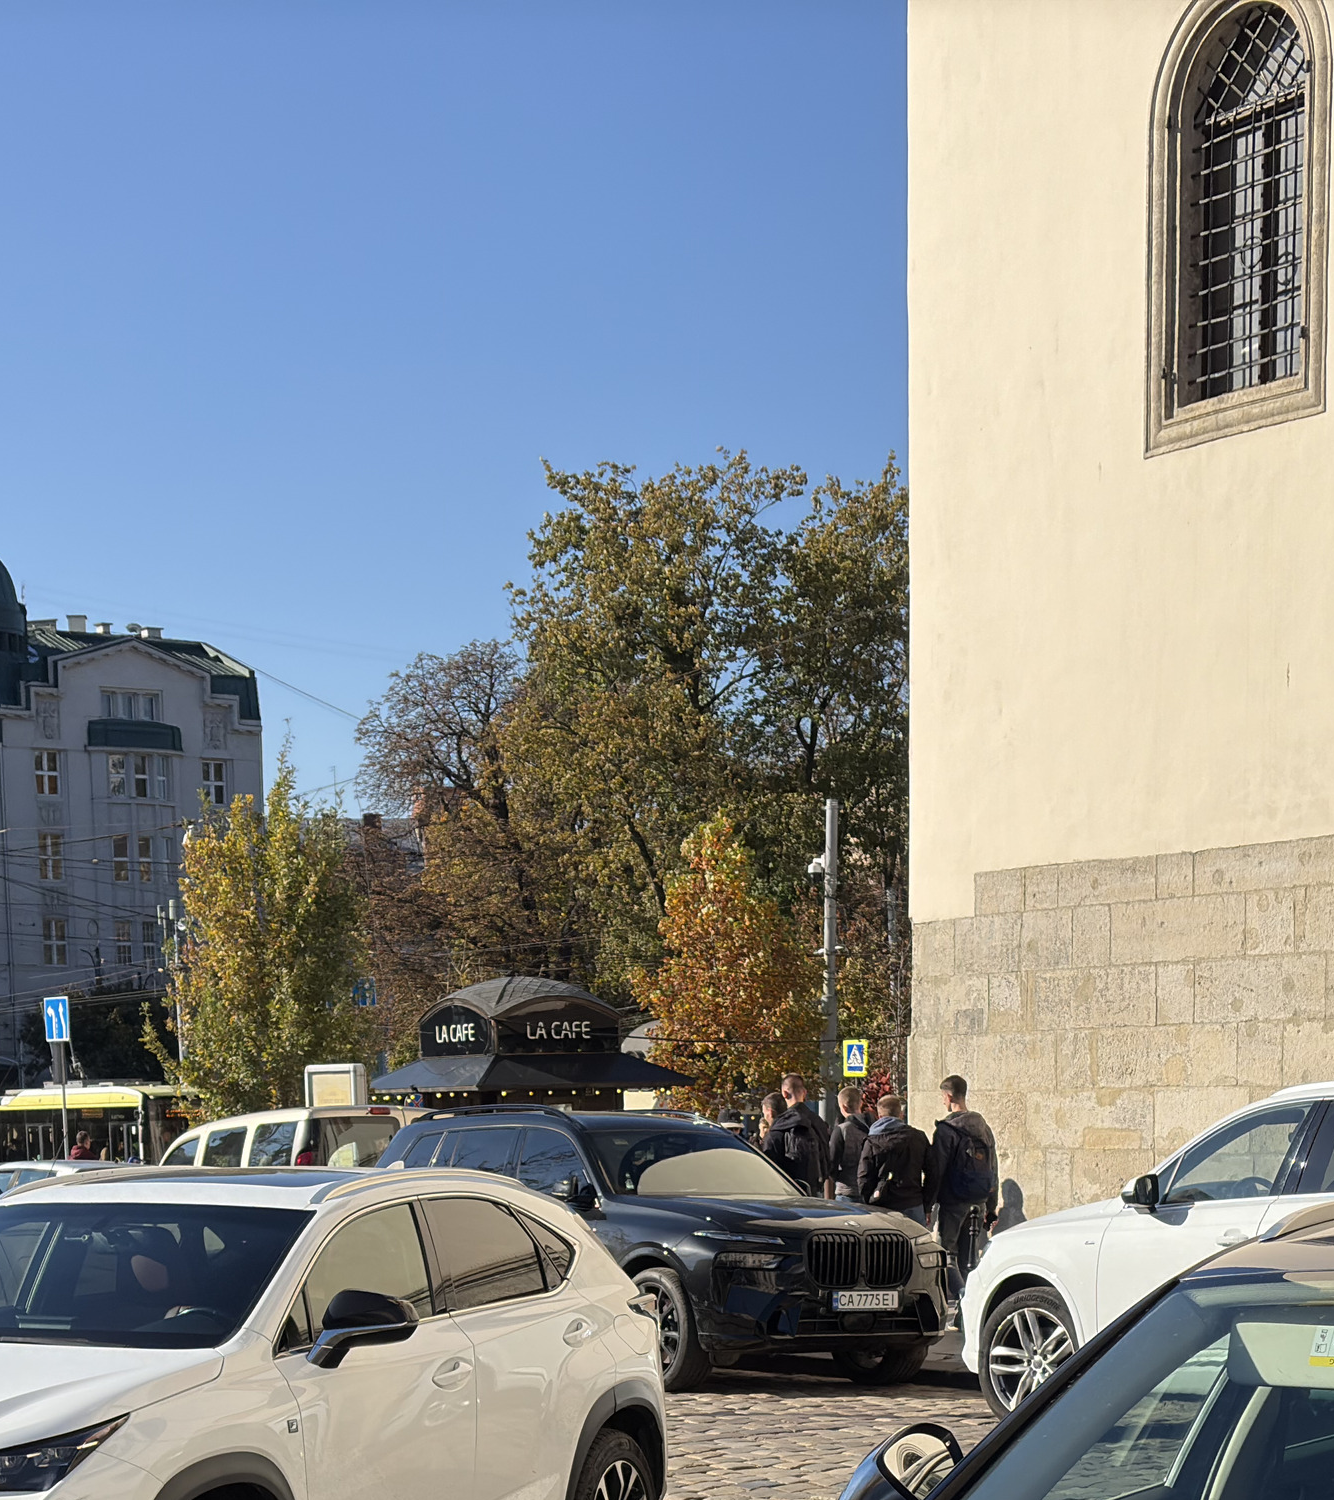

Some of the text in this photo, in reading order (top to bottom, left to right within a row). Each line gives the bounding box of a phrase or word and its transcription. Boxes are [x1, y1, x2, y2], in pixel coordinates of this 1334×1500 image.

[435, 1023, 475, 1043] LA CAFE
[527, 1021, 591, 1040] LA CAFE
[839, 1294, 854, 1306] CA
[857, 1294, 880, 1306] 7775
[883, 1294, 894, 1306] EI
[1013, 1294, 1061, 1311] BRIDGESTONE
